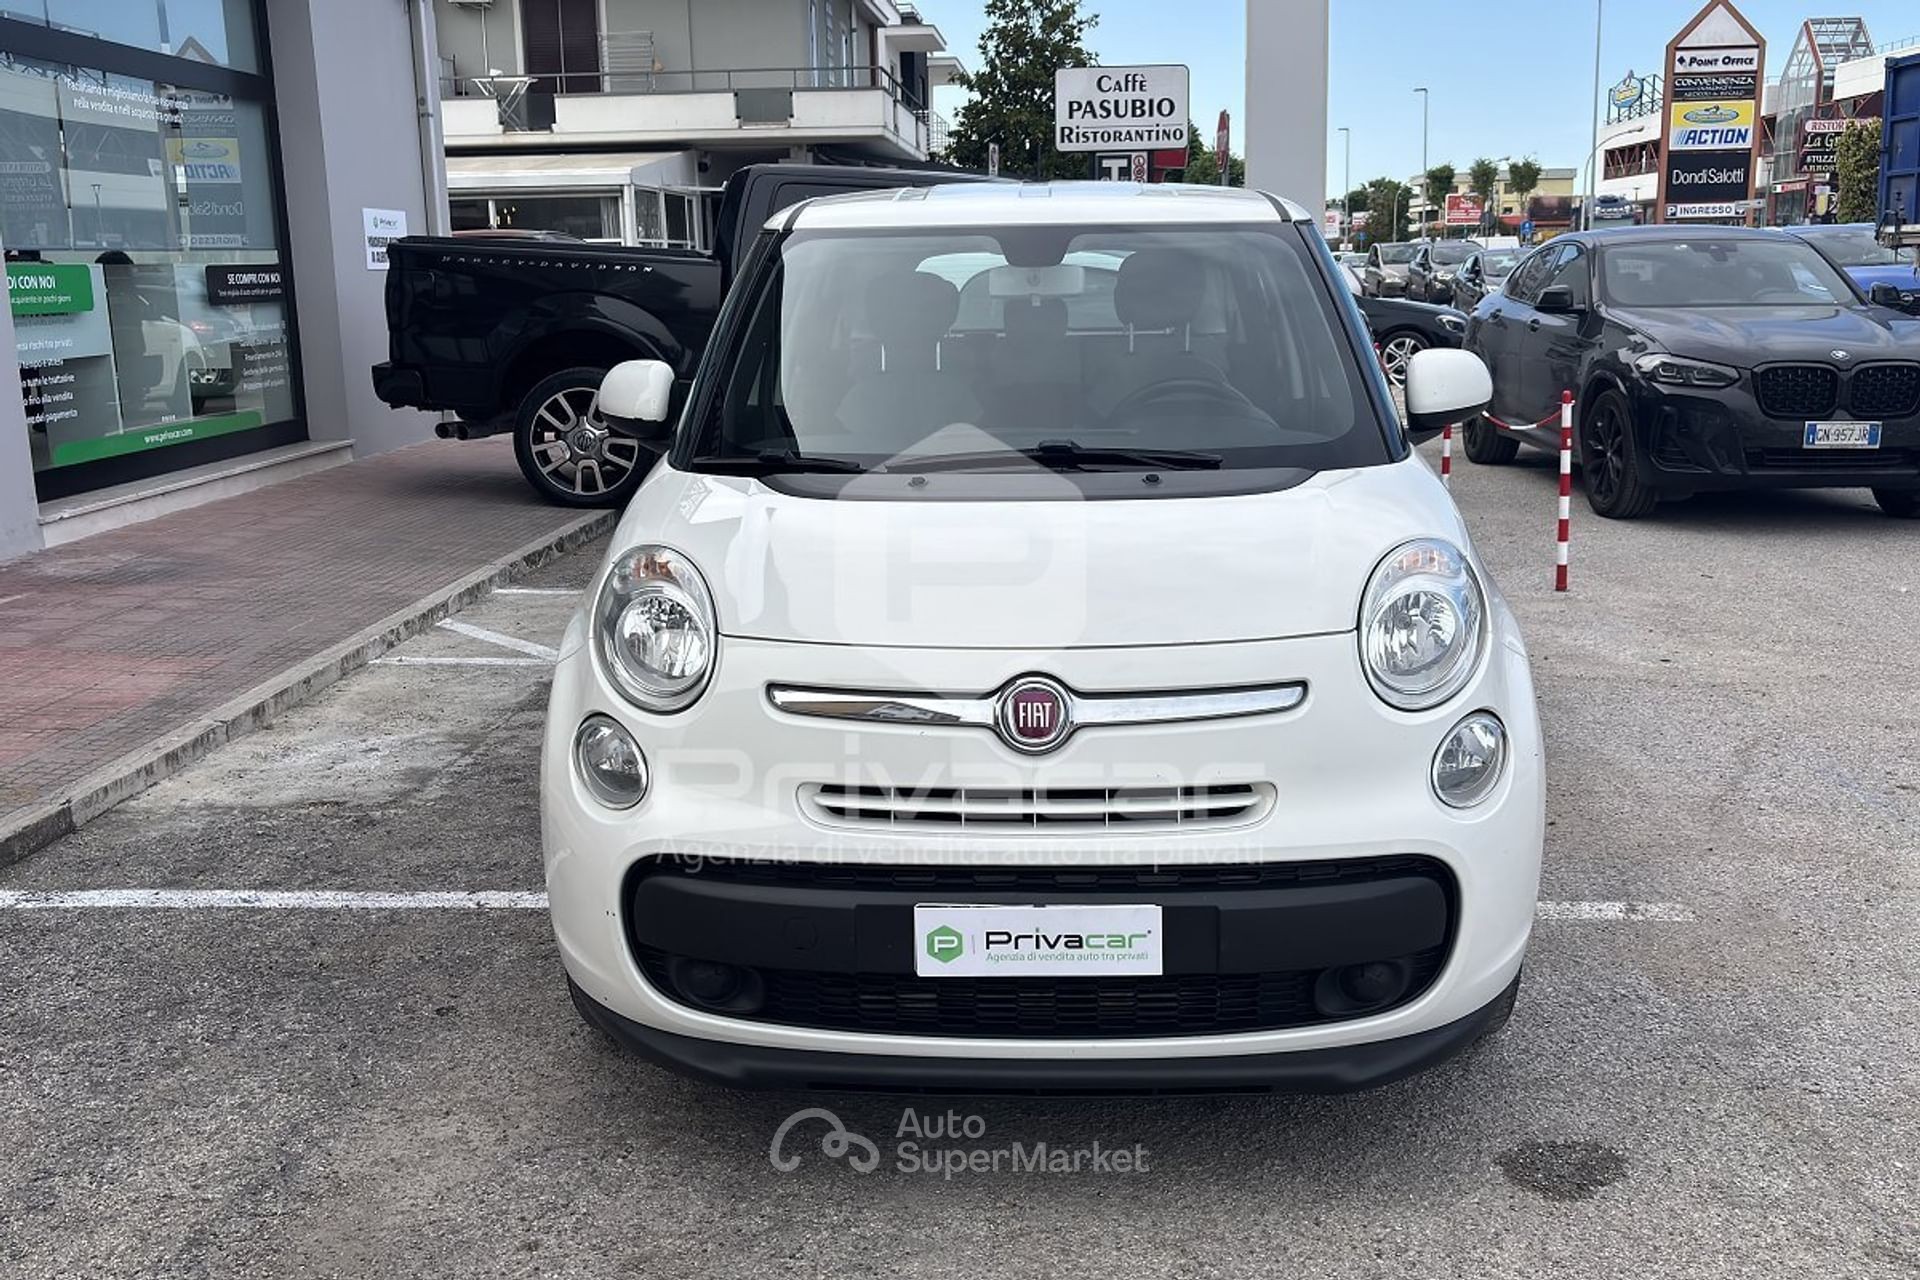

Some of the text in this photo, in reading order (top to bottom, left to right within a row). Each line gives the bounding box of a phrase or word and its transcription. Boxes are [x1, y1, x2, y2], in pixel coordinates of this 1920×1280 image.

[1068, 98, 1175, 119] PASUBIO
[1684, 128, 1749, 145] ACTION
[1804, 133, 1821, 147] La
[1680, 205, 1733, 215] INGRESSO
[441, 256, 653, 273] HARLEY-DAVIDSON
[18, 275, 38, 289] CON
[39, 274, 56, 289] NOI
[1019, 702, 1052, 728] FIAT
[985, 928, 1148, 950] Privacar
[986, 952, 1149, 963] Agenzia di vendita auto tra privati
